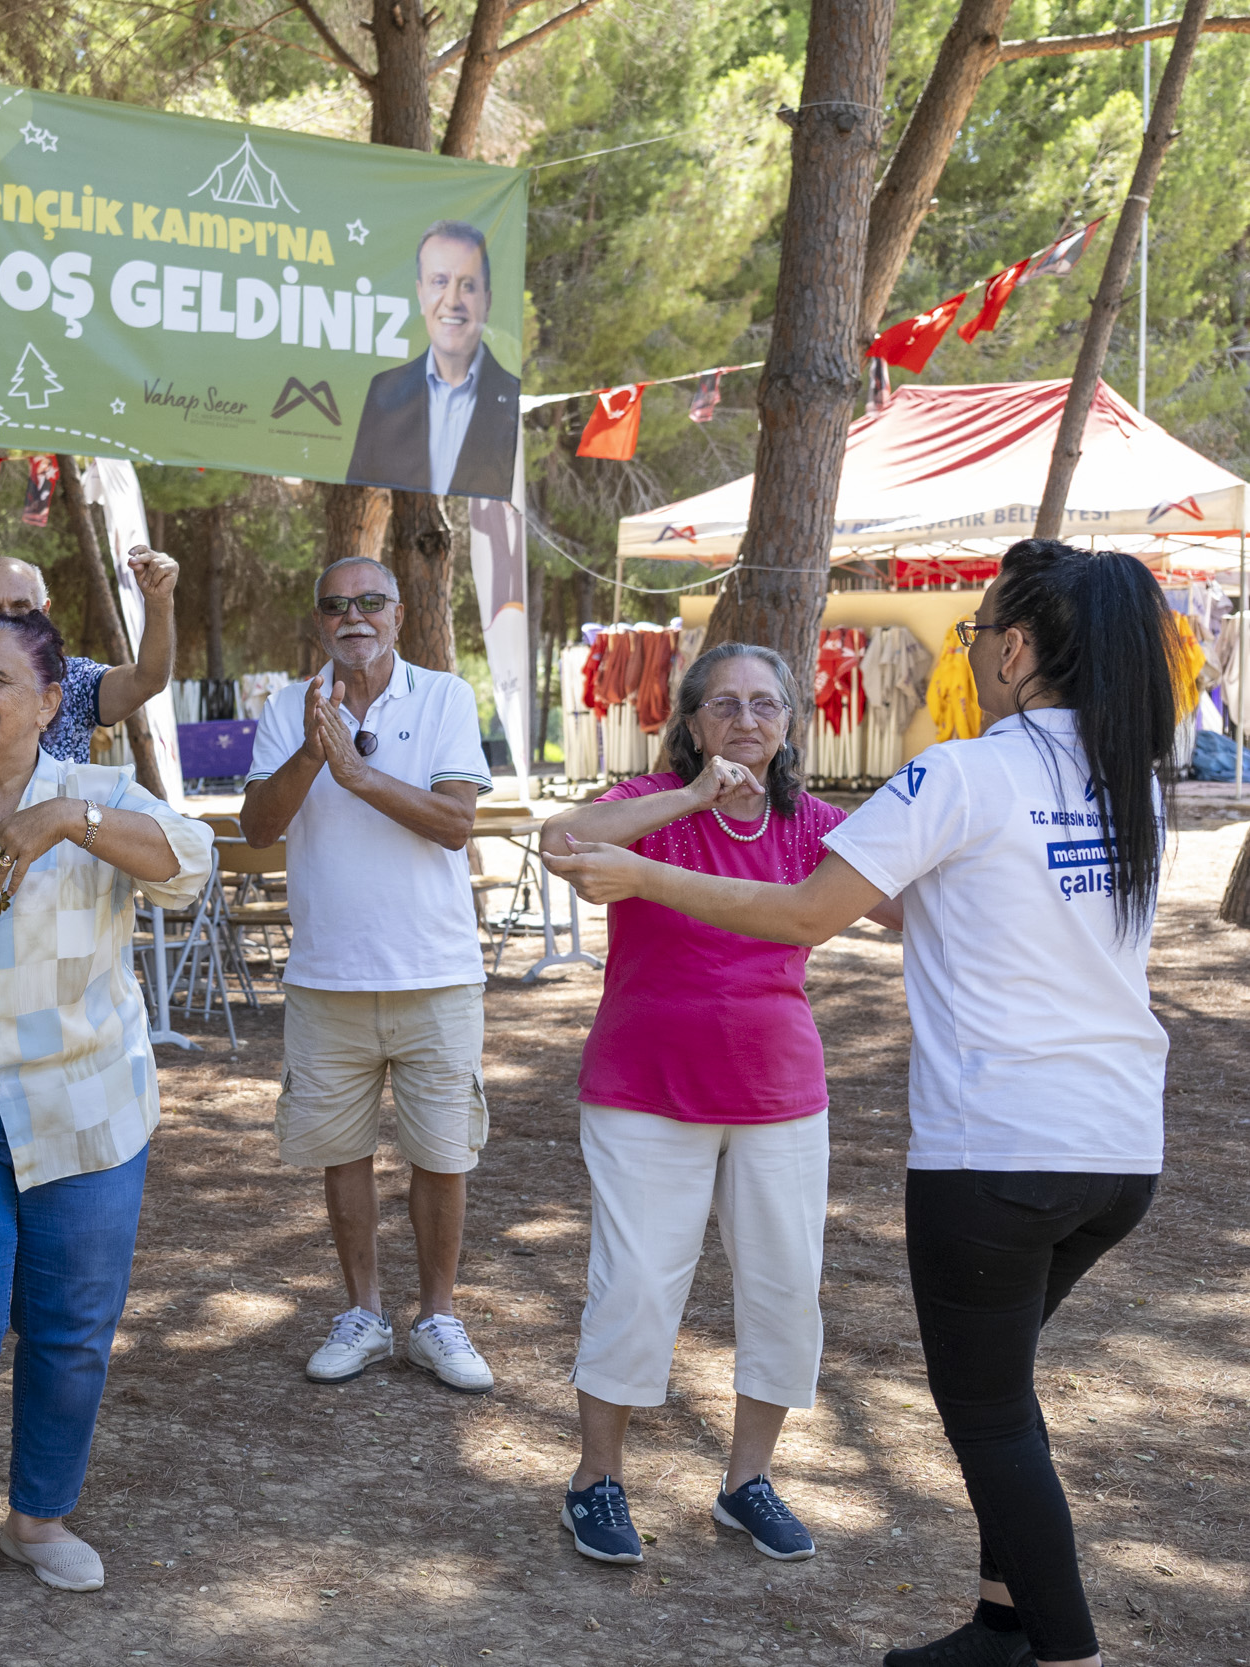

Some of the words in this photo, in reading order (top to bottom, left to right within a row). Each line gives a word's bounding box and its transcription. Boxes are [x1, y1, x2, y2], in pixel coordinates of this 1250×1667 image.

[110, 260, 410, 359] GELDİNİZ
[144, 378, 199, 422] Vahap
[1030, 810, 1049, 825] T.C.
[1051, 810, 1085, 827] MERSİN
